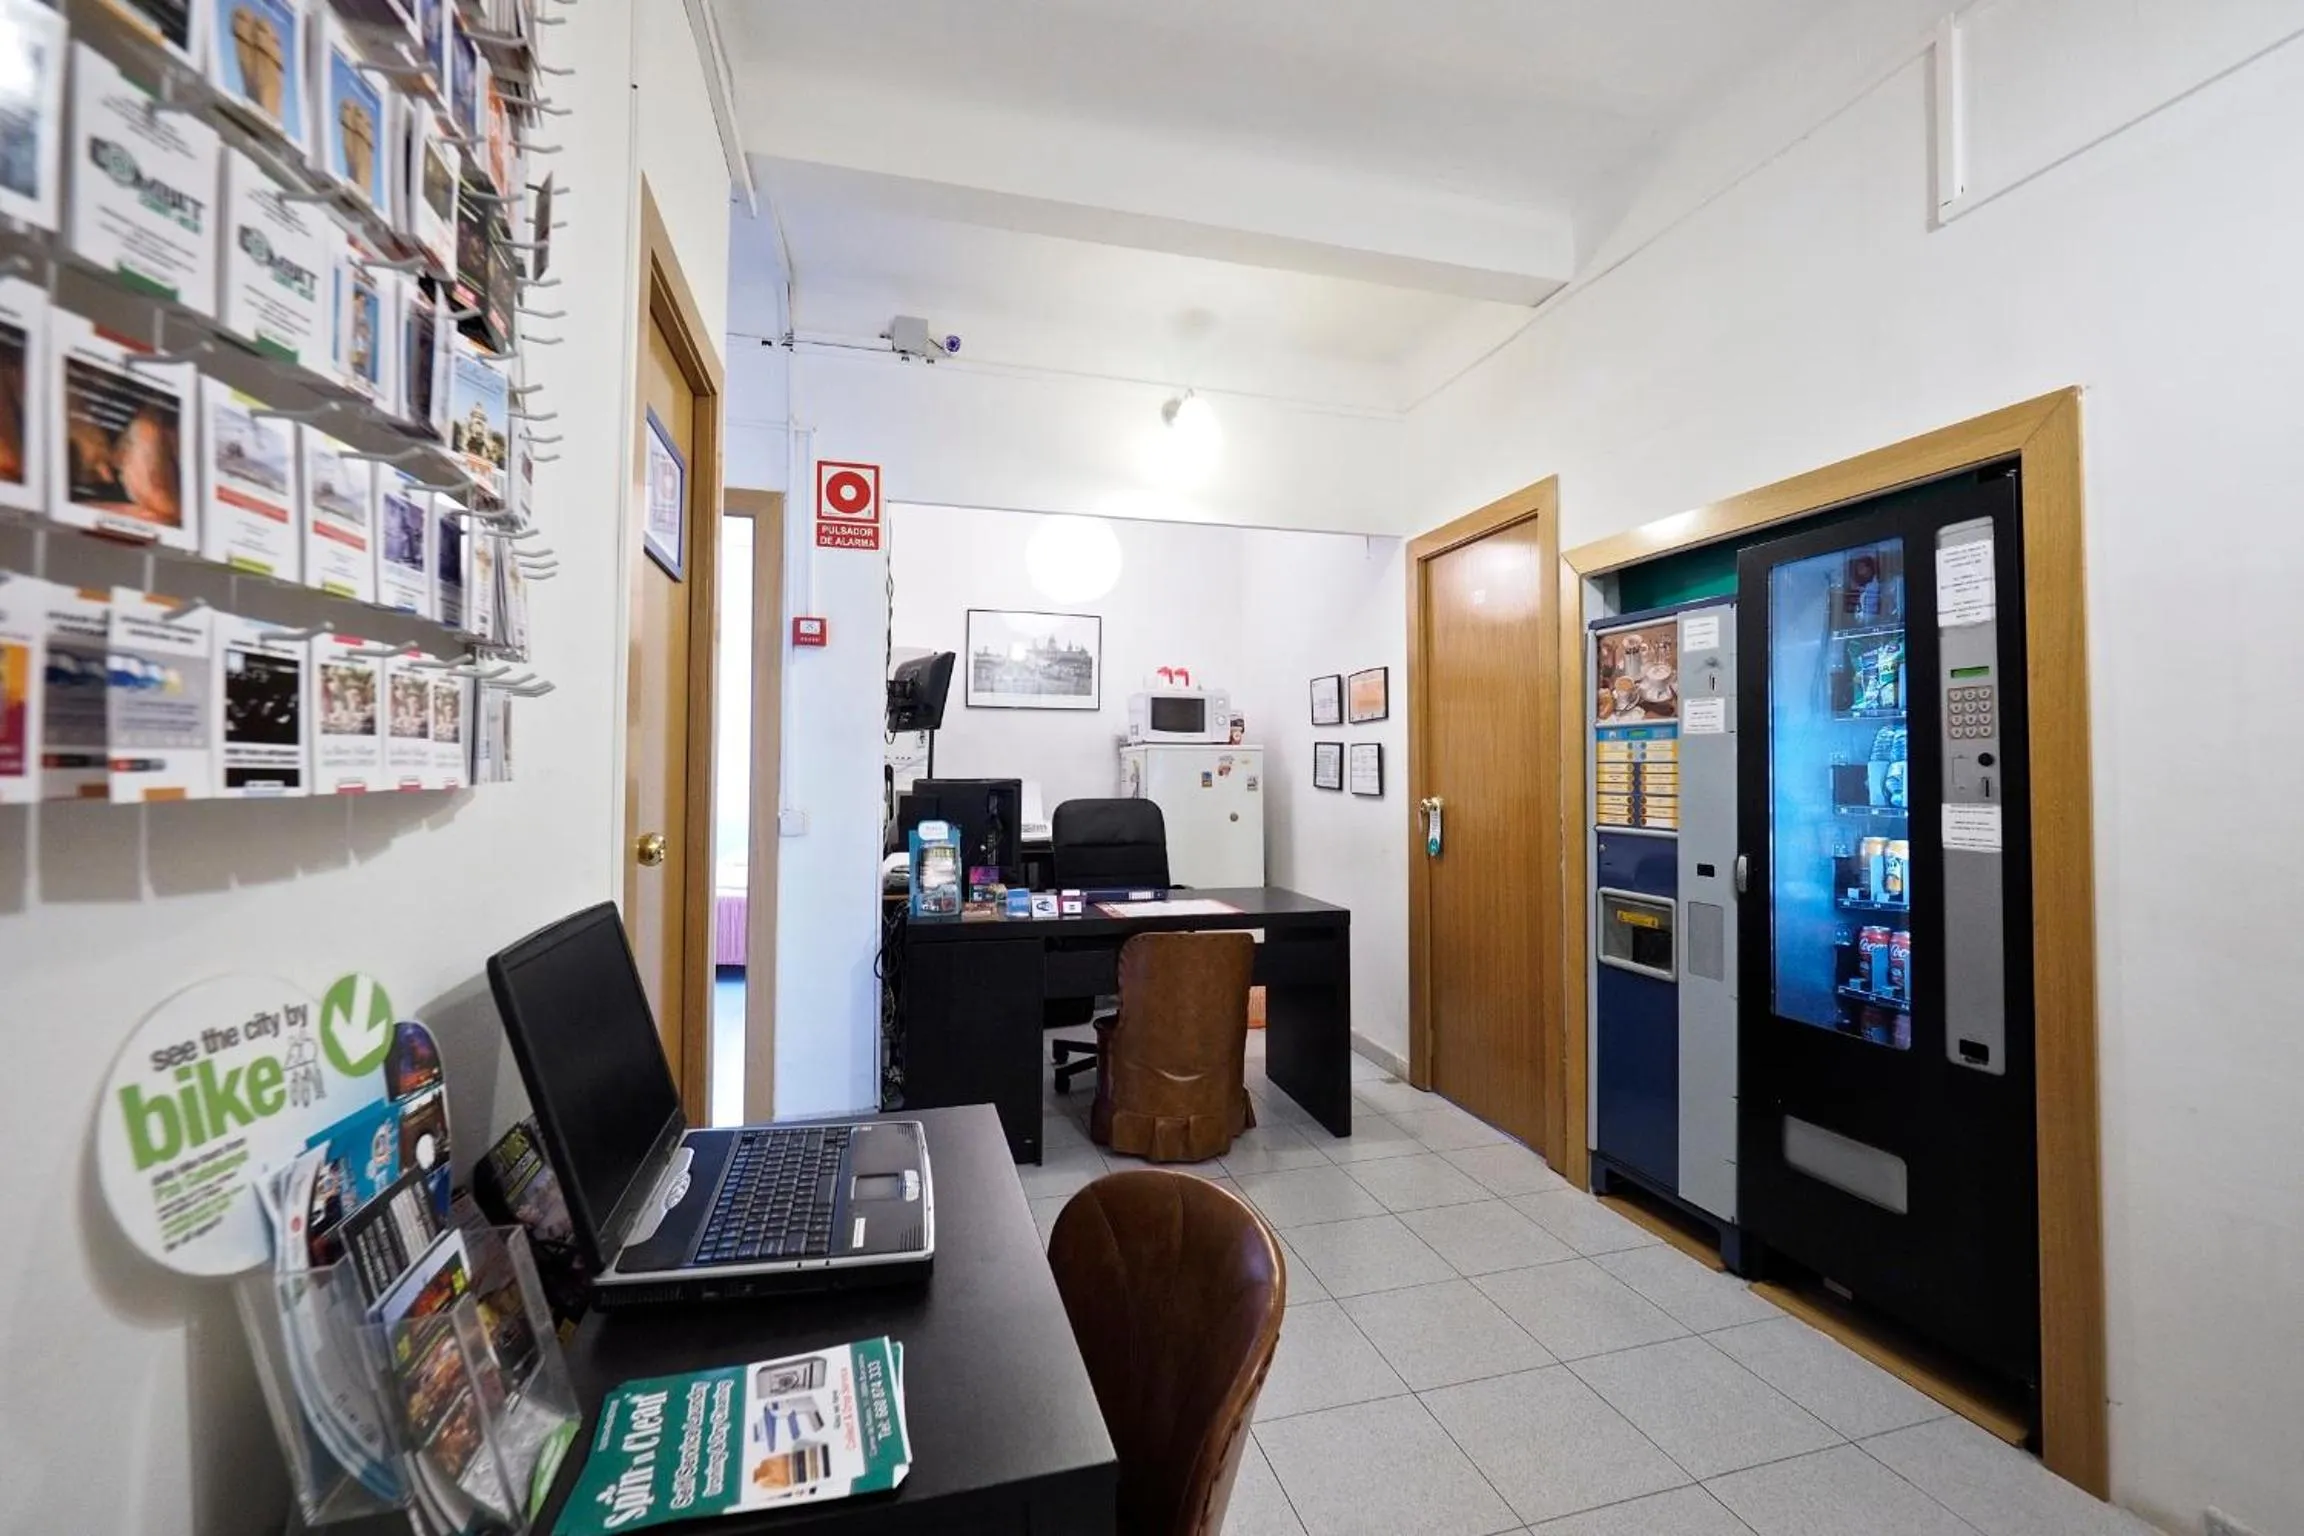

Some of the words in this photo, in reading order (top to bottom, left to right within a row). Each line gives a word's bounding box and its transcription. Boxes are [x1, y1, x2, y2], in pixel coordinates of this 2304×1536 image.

[820, 536, 833, 545] DE
[835, 537, 876, 548] ALARMA
[821, 525, 874, 537] PULSADOR
[150, 1040, 198, 1072] see
[201, 1026, 240, 1054] the
[244, 1010, 281, 1038] city
[284, 1003, 308, 1028] by
[117, 1055, 288, 1172] bike
[621, 1390, 669, 1452] Clean
[602, 1466, 656, 1529] Spin
